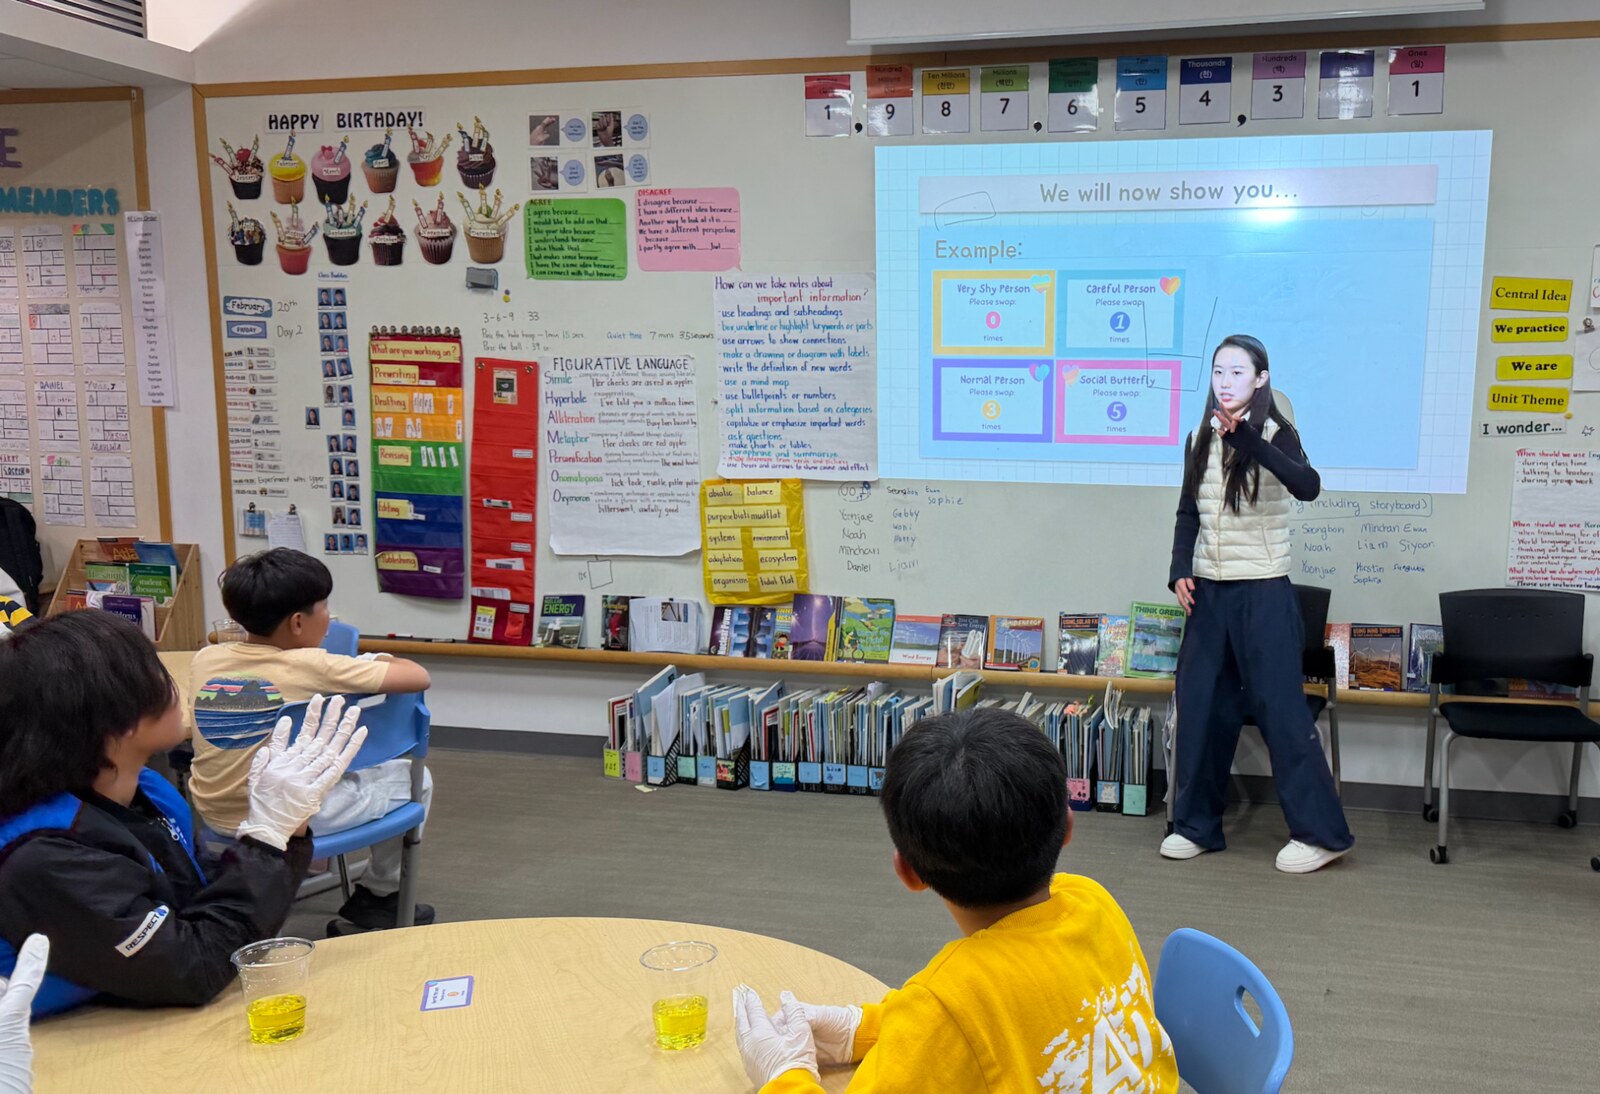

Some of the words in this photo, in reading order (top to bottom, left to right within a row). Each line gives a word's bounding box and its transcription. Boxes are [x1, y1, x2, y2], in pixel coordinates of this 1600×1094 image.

[1188, 60, 1225, 68] Thousands
[1273, 85, 1283, 101] 3
[1412, 80, 1419, 97] 1
[1199, 90, 1211, 106] 4
[886, 104, 895, 119] 9
[941, 101, 951, 116] 8
[1000, 98, 1010, 114] 7
[1068, 99, 1077, 115] 6
[1136, 97, 1145, 113] 5
[825, 105, 831, 120] 1
[269, 114, 319, 130] HAPPY
[337, 112, 423, 128] BIRTHDAY!
[1040, 184, 1069, 202] We
[1079, 183, 1110, 201] will
[1119, 188, 1161, 201] now
[1170, 181, 1224, 200] show
[1233, 184, 1297, 205] you...
[0, 186, 120, 217] MEMBERS
[935, 240, 1023, 263] Example:
[716, 277, 734, 289] How
[771, 277, 786, 288] take
[789, 278, 808, 288] notes
[812, 277, 832, 288] about
[957, 284, 976, 295] Very
[979, 284, 997, 295] Shy
[1000, 285, 1030, 293] Person
[1086, 284, 1120, 293] Careful
[1124, 285, 1155, 293] Person
[757, 289, 802, 305] important
[1495, 287, 1538, 300] Central
[1542, 290, 1566, 301] Idea
[232, 301, 265, 312] February
[1096, 298, 1120, 306] Please
[528, 311, 539, 321] 33
[737, 305, 772, 321] headings
[775, 306, 789, 316] and
[794, 305, 843, 319] subheadings
[985, 311, 1001, 329] 0
[1115, 314, 1124, 329] 1
[277, 325, 294, 339] Day
[296, 325, 302, 335] 2
[607, 331, 626, 340] Quiet
[629, 331, 642, 340] time
[650, 331, 656, 340] 7
[1495, 325, 1513, 333] We
[1516, 324, 1565, 334] practice
[737, 337, 764, 345] arrows
[769, 334, 776, 344] to
[780, 333, 798, 344] show
[803, 333, 846, 344] connections
[371, 344, 388, 354] What
[401, 348, 412, 359] you
[413, 346, 440, 359] working
[553, 357, 632, 371] FIGURATIVE
[637, 357, 688, 370] LANGUAGE
[1512, 362, 1532, 371] We
[1535, 363, 1557, 371] are
[375, 368, 416, 383] Prewriting
[544, 372, 572, 385] Simile
[961, 376, 991, 384] Normal
[995, 376, 1025, 384] Person
[1080, 376, 1107, 384] Social
[1111, 375, 1155, 386] Butterfly
[40, 381, 64, 390] DANIEL
[545, 391, 587, 407] Hyperbole
[804, 387, 836, 399] numbers
[1093, 389, 1117, 397] Please
[1492, 393, 1518, 404] Unit
[1521, 395, 1564, 406] Theme
[375, 395, 406, 410] Drafting
[547, 411, 595, 424] Alliteration
[1483, 424, 1489, 434] I
[1497, 421, 1562, 434] wonder...
[547, 431, 589, 446] Metaphor
[728, 431, 743, 440] ask
[747, 431, 782, 443] questions
[380, 449, 409, 462] Revising
[747, 487, 773, 496] balance
[928, 496, 963, 506] Sophie
[378, 504, 399, 516] Editing
[751, 510, 781, 519] mudflat
[709, 531, 735, 544] systems
[1305, 543, 1331, 552] Noah
[1358, 541, 1388, 550] Liam
[760, 553, 797, 566] ecosystem
[847, 560, 871, 572] Daniel
[1302, 560, 1336, 578] Yoonjae
[780, 575, 794, 584] flat
[544, 604, 576, 614] ENERGY
[1135, 606, 1157, 614] THINK
[1159, 609, 1184, 617] GREEN
[718, 631, 728, 654] Nuclear
[724, 609, 732, 629] Power
[125, 913, 159, 952] RESPECT
